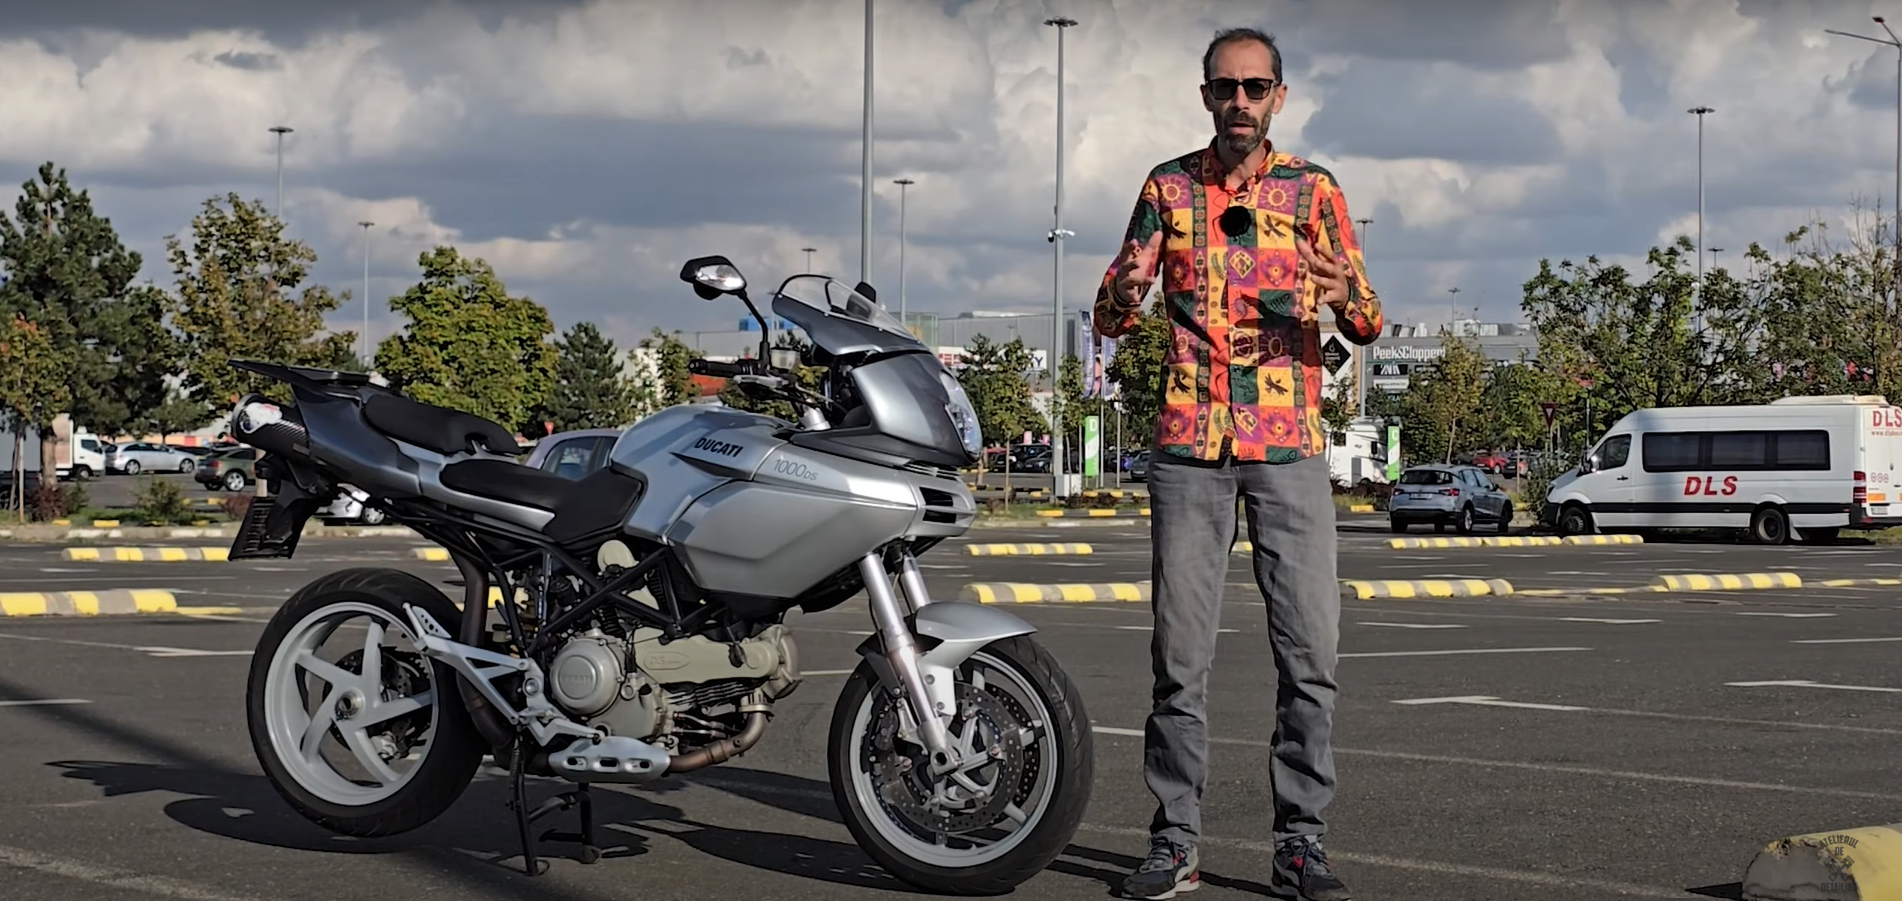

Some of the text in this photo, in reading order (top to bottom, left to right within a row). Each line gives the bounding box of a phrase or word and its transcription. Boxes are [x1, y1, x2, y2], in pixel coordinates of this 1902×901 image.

[1089, 418, 1097, 432] D
[694, 437, 743, 458] DUCATI
[1684, 475, 1738, 496] DLS
